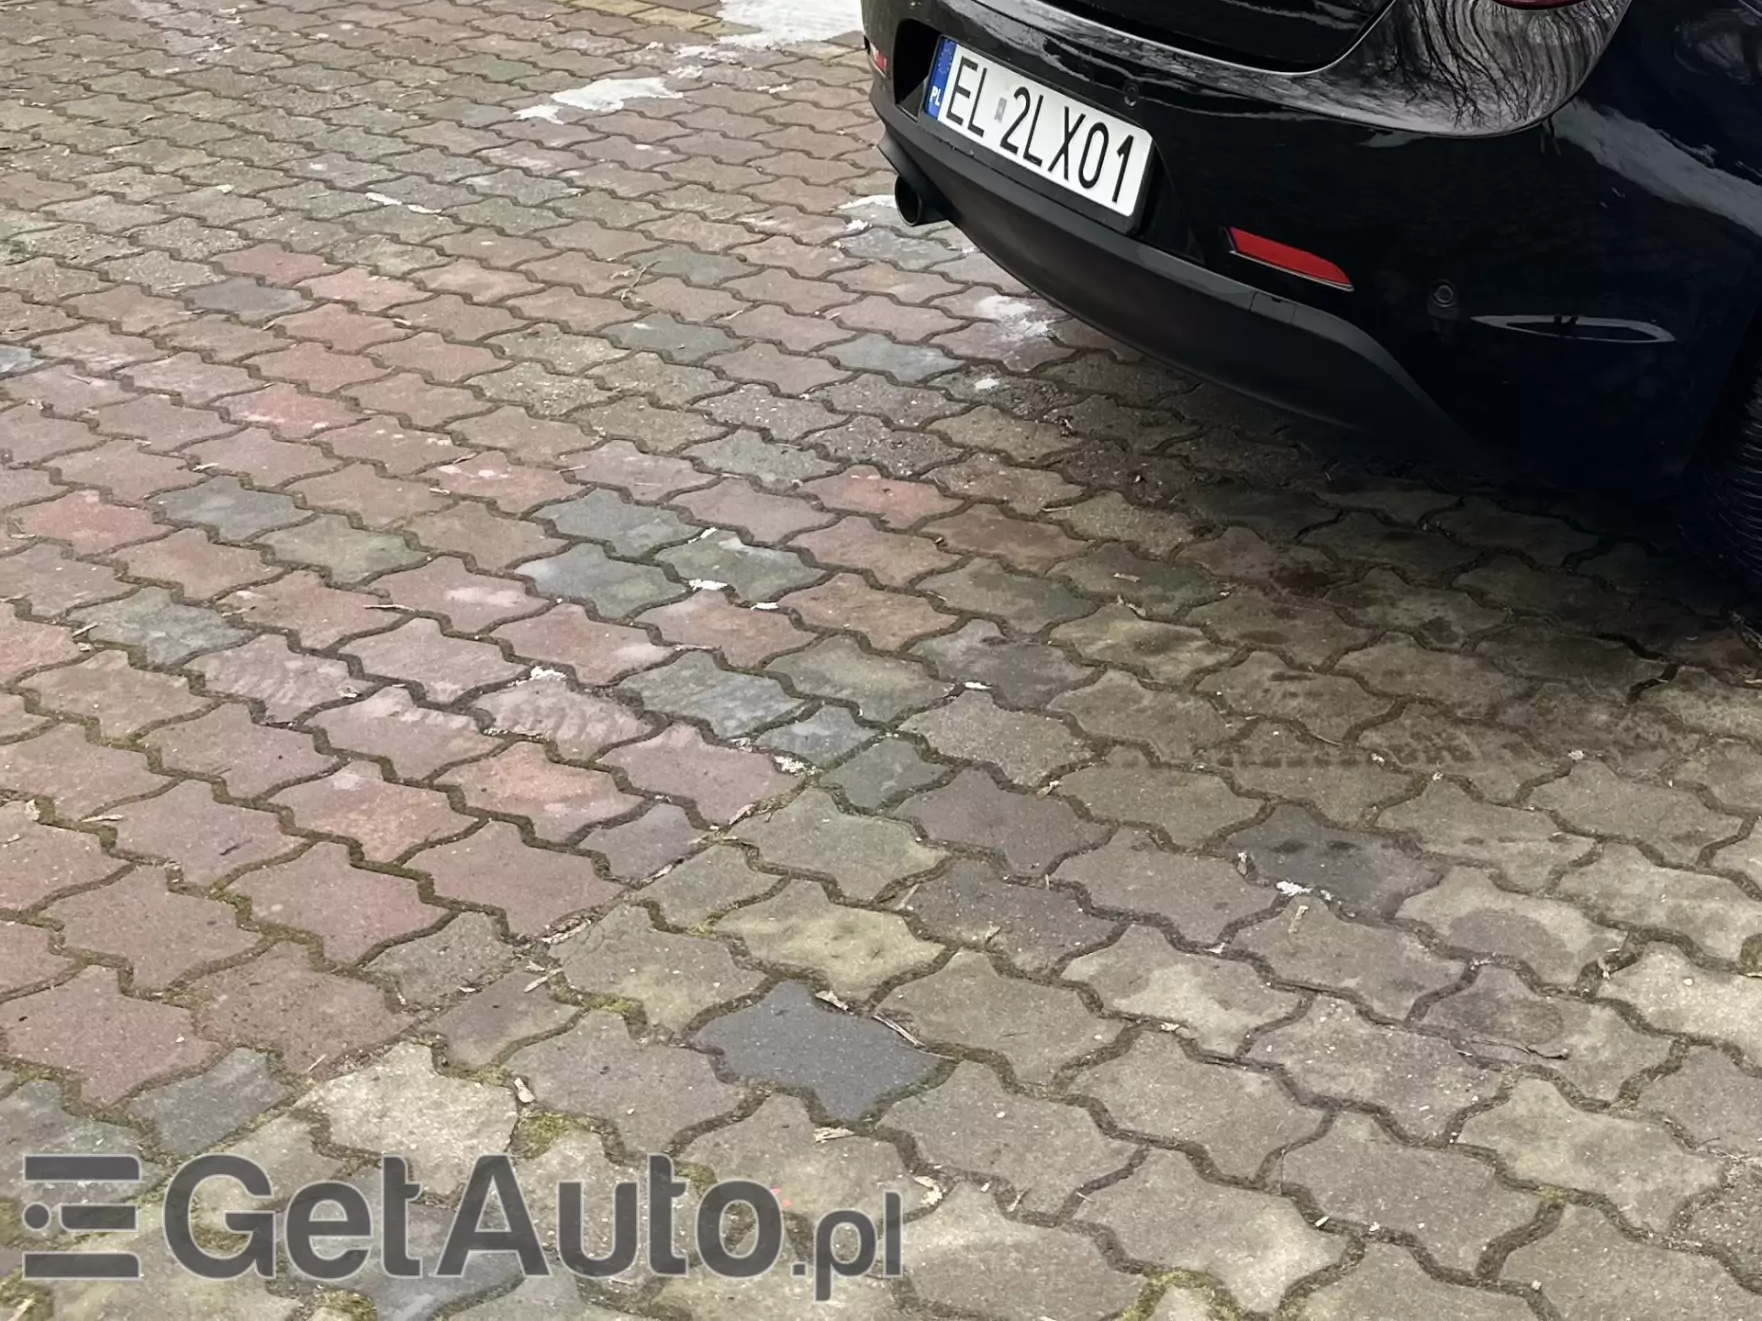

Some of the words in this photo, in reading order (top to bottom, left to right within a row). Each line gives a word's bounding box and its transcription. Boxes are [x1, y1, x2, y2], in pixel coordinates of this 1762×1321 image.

[929, 85, 942, 107] PL
[946, 55, 988, 138] EL
[999, 86, 1135, 204] 2LX01
